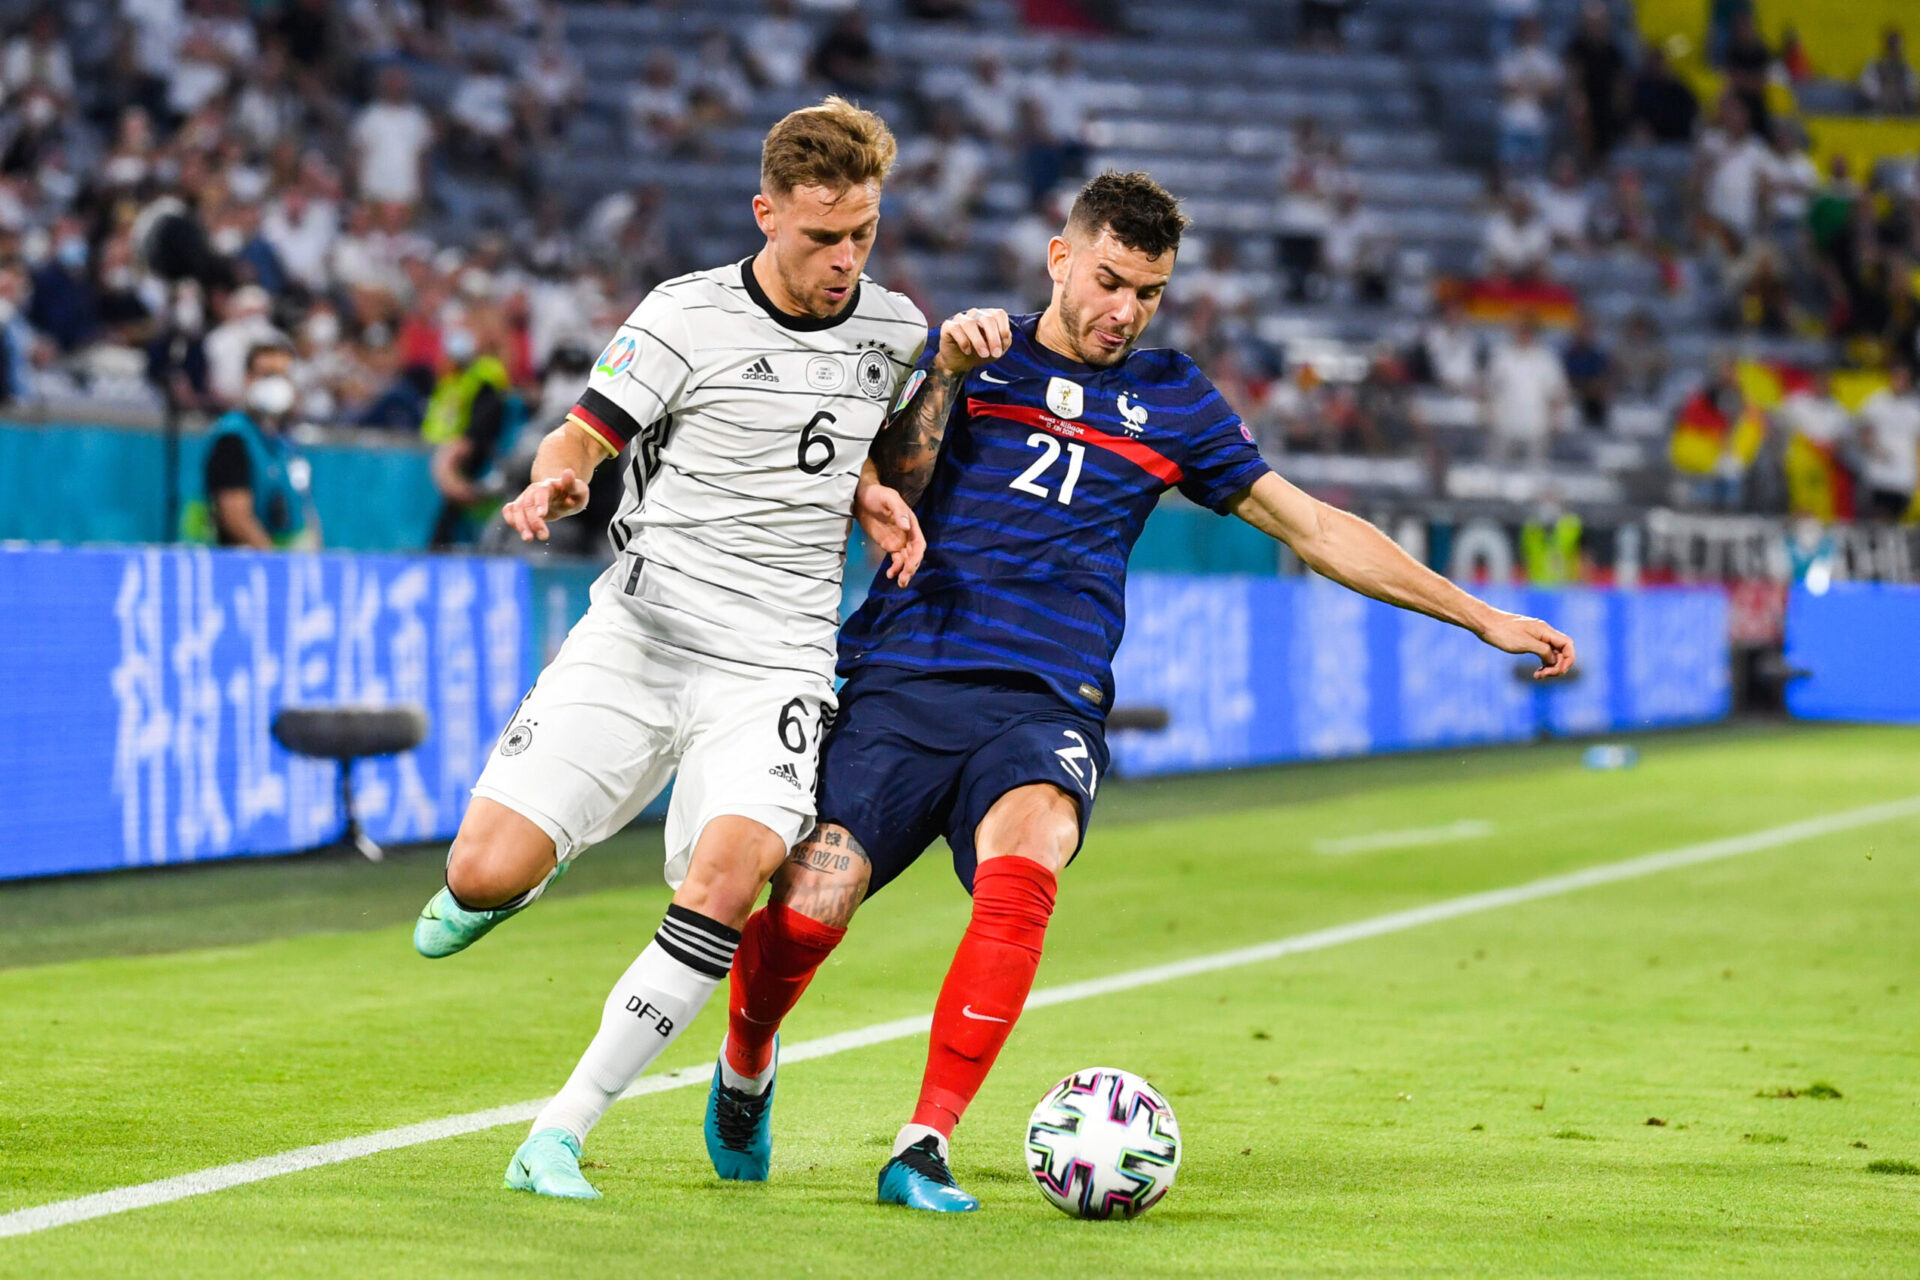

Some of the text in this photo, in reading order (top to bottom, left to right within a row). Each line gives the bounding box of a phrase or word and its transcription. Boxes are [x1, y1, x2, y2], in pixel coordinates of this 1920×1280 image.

[741, 371, 780, 383] adidas
[797, 410, 837, 475] 6
[1008, 432, 1086, 505] 21
[778, 697, 810, 754] 6
[768, 768, 802, 791] adidas
[625, 995, 674, 1037] DFB
